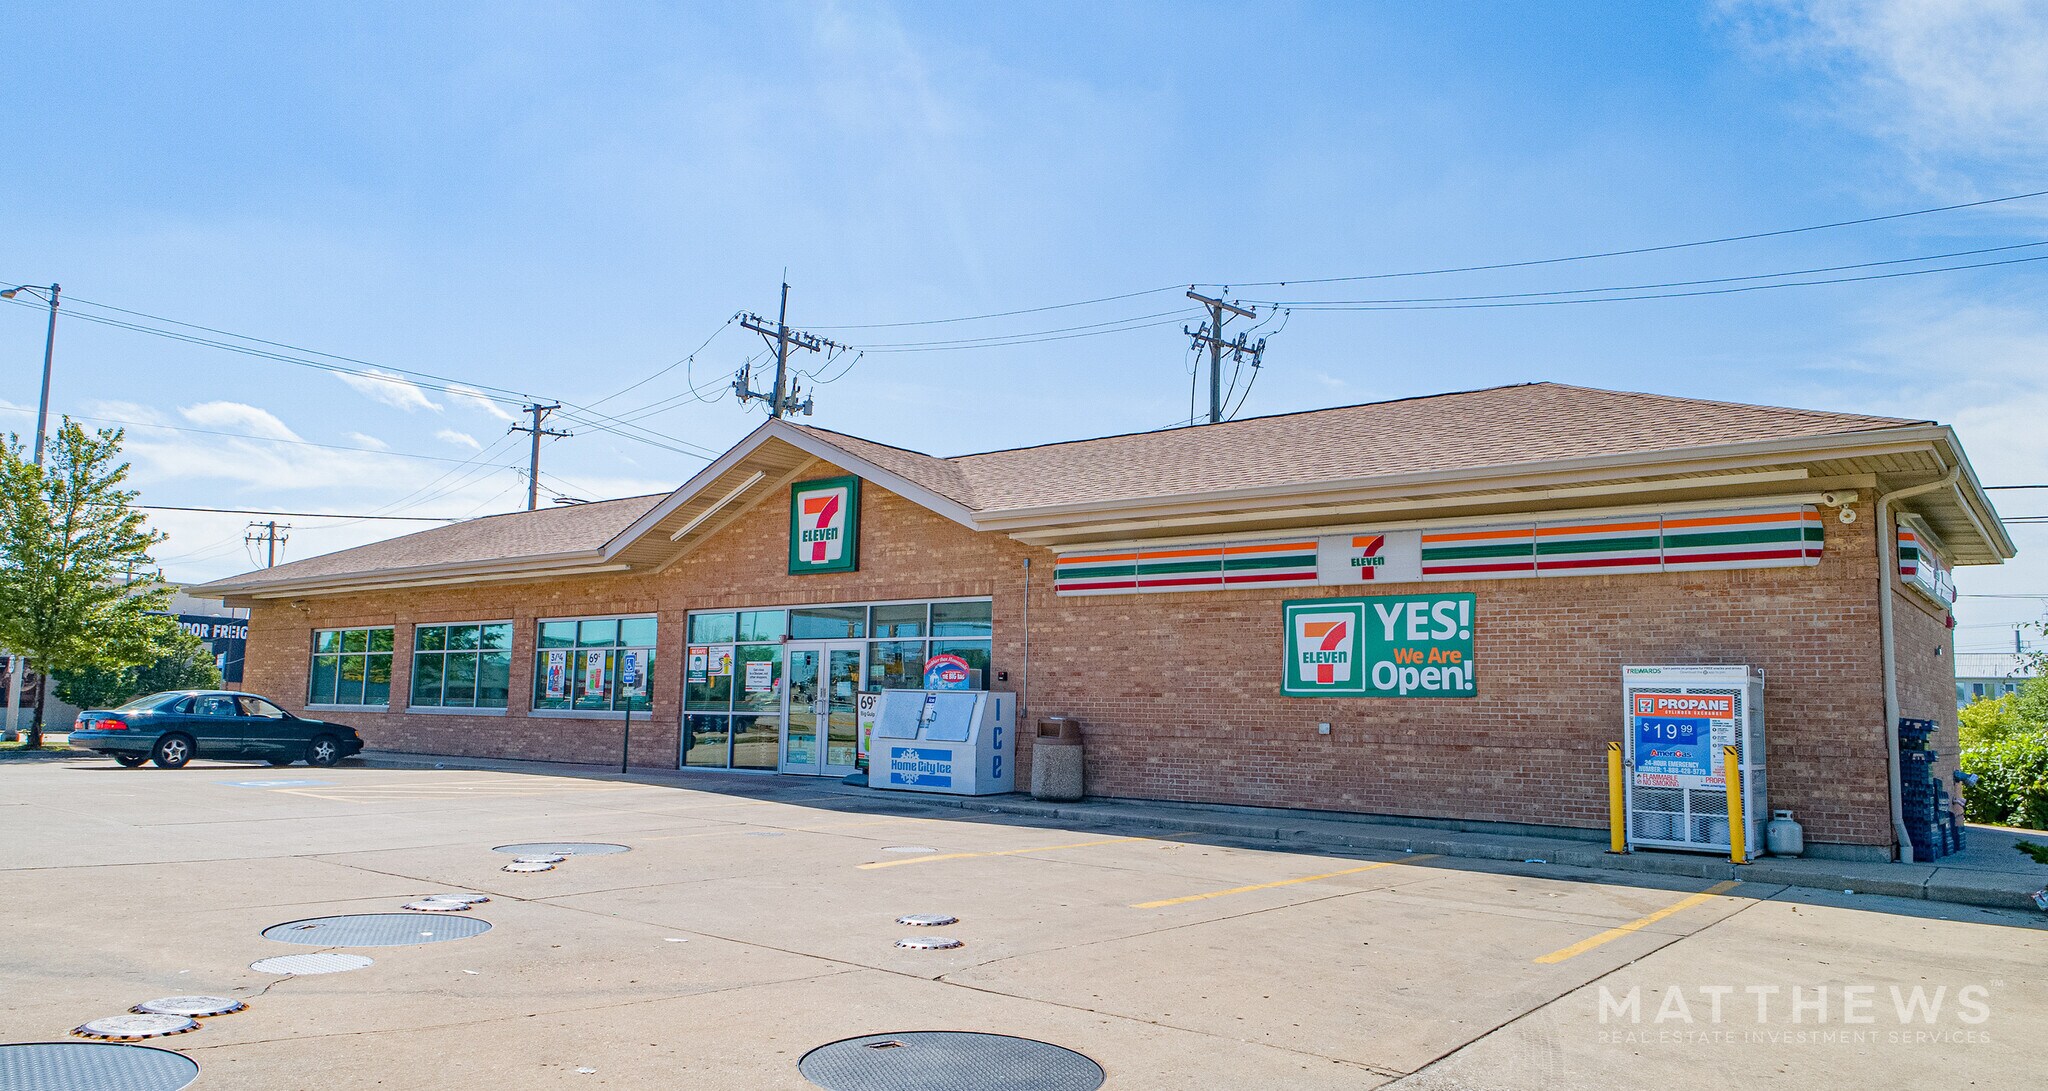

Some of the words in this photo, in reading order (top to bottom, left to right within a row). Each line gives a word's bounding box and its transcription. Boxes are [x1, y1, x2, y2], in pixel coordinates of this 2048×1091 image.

[803, 527, 838, 542] ELEVEN
[804, 494, 839, 561] 7
[1351, 556, 1384, 567] ELEVEN
[1352, 535, 1384, 580] 7
[1373, 600, 1470, 641] YES!
[1303, 651, 1347, 664] ELEVEN
[1304, 621, 1346, 683] 7
[1393, 648, 1423, 664] We
[1428, 647, 1462, 664] Are
[1371, 660, 1473, 695] Open!
[1658, 699, 1729, 711] PROPANE
[891, 759, 917, 771] Home
[917, 761, 936, 774] City
[936, 762, 951, 773] Ice
